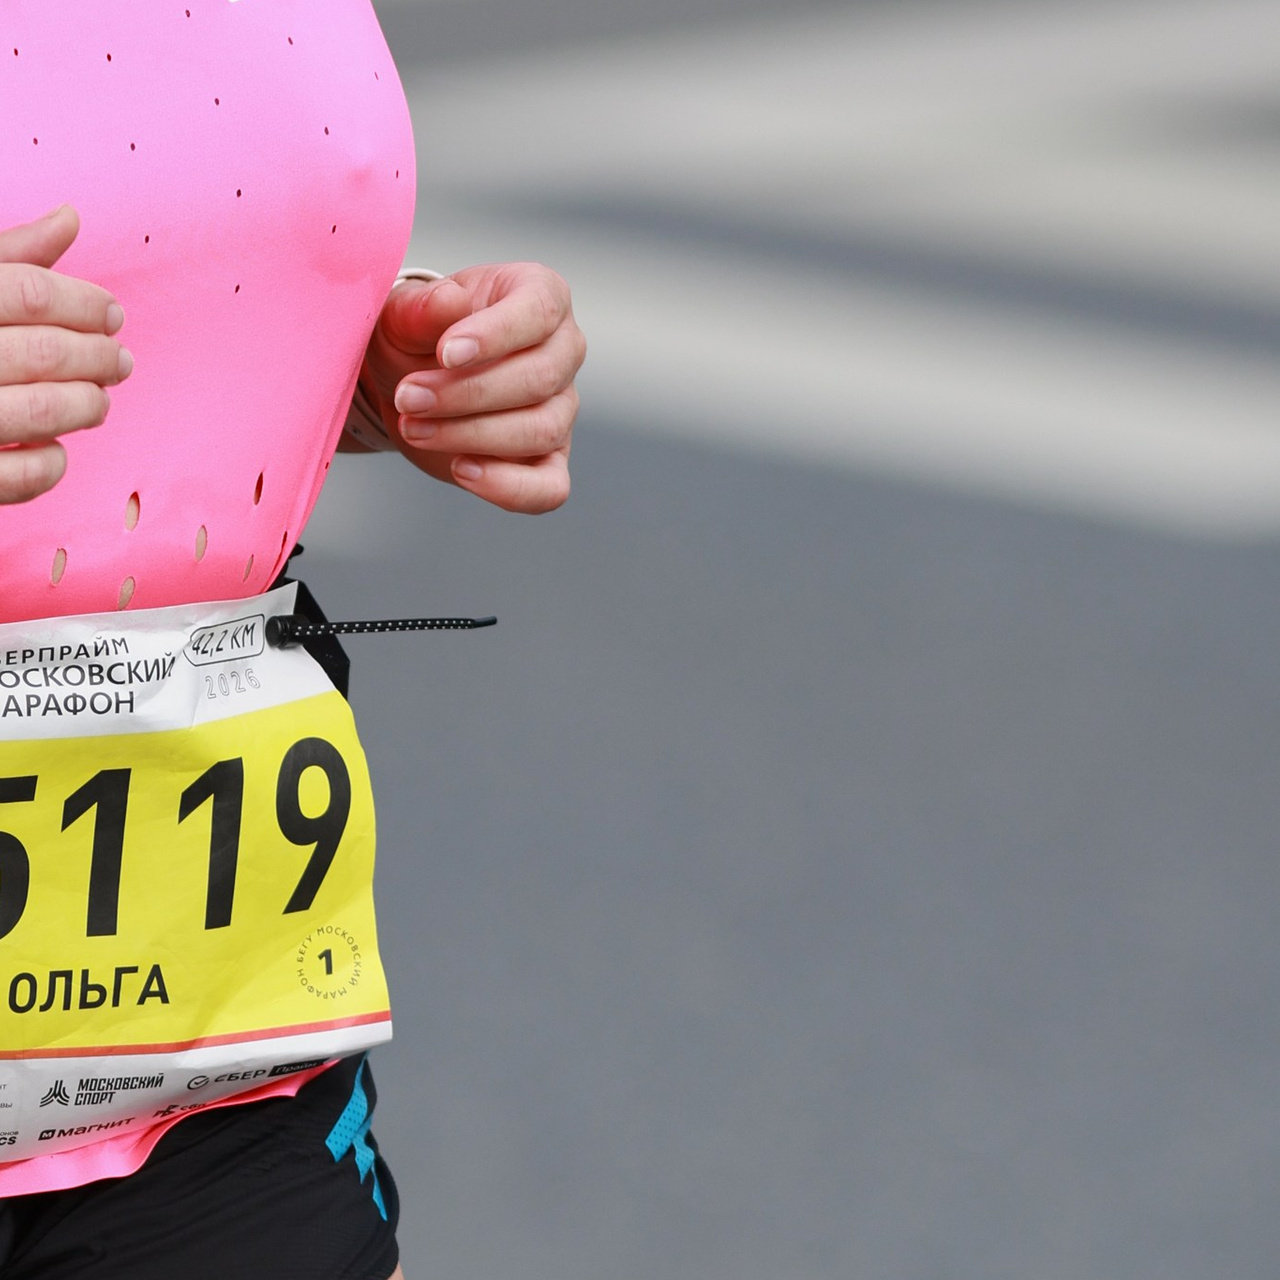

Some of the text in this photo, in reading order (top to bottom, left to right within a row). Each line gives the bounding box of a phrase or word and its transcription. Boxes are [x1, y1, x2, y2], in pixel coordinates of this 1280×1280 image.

[192, 629, 228, 657] 42,2
[205, 668, 261, 699] 2026
[317, 948, 333, 976] 1
[8, 964, 170, 1014] ОЛЬГА
[77, 1072, 164, 1092] МОСКОВСКИЙ
[214, 1070, 267, 1082] СБЕР
[74, 1091, 116, 1105] СПОРТ
